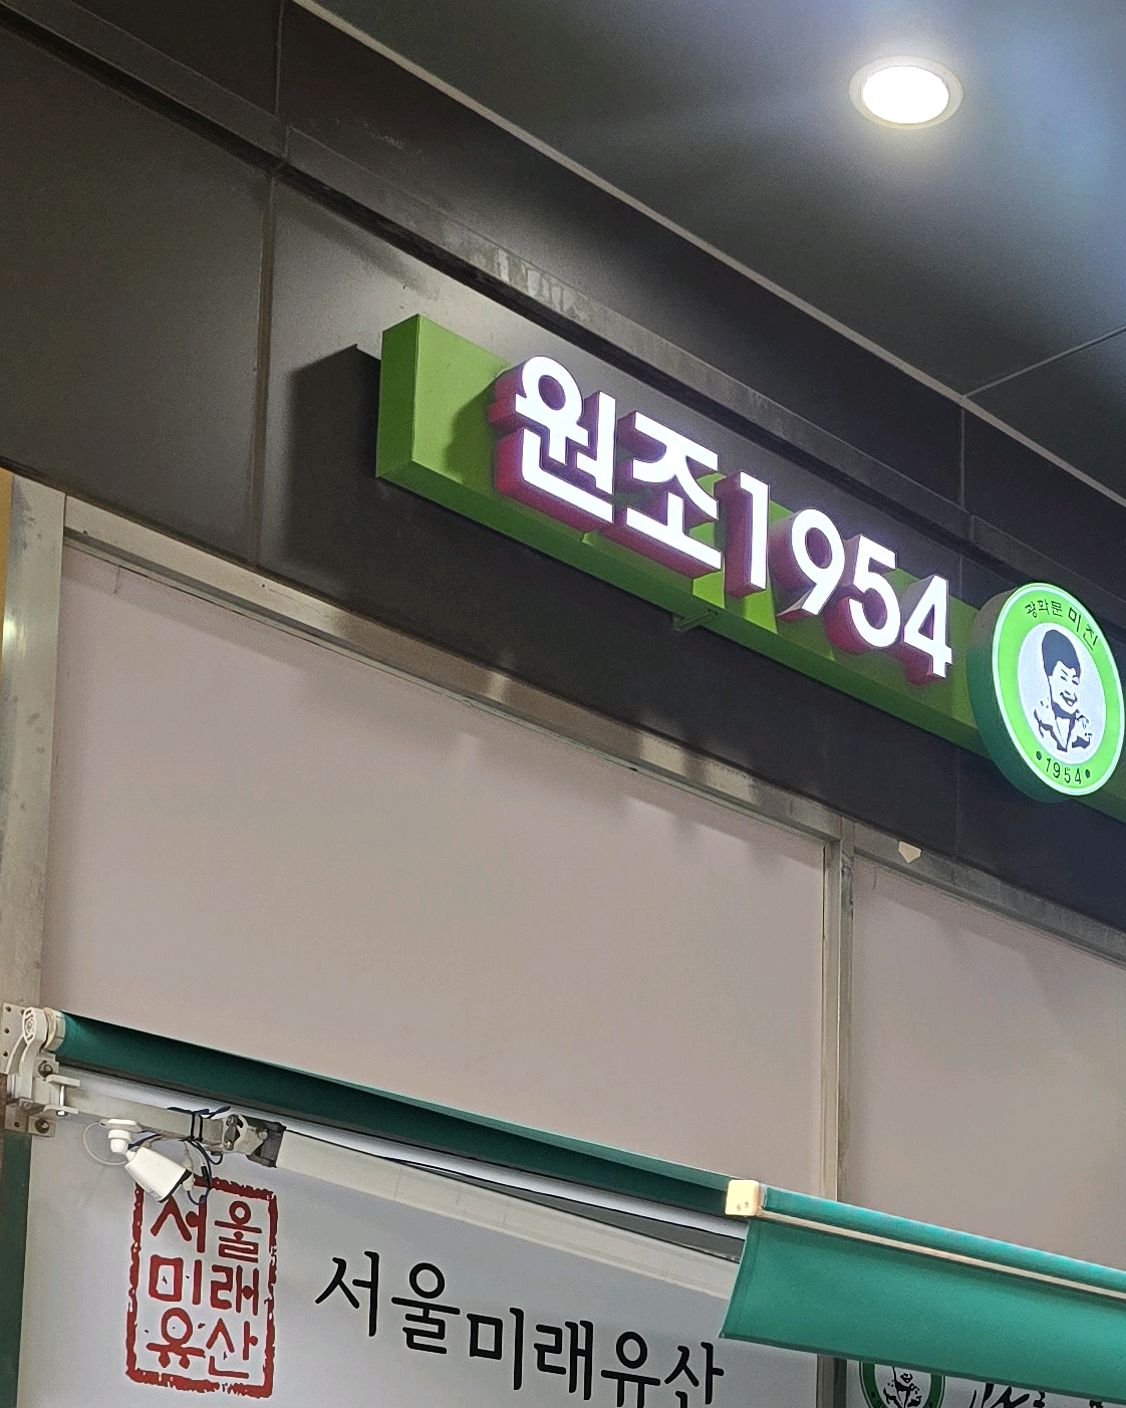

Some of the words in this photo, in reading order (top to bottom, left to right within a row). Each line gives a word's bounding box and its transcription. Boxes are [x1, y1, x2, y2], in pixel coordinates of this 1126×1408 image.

[1068, 607, 1098, 651] 미진
[1044, 757, 1082, 785] 1954
[150, 1195, 262, 1264] 서울
[148, 1254, 260, 1316] 미래
[146, 1307, 259, 1379] 유산
